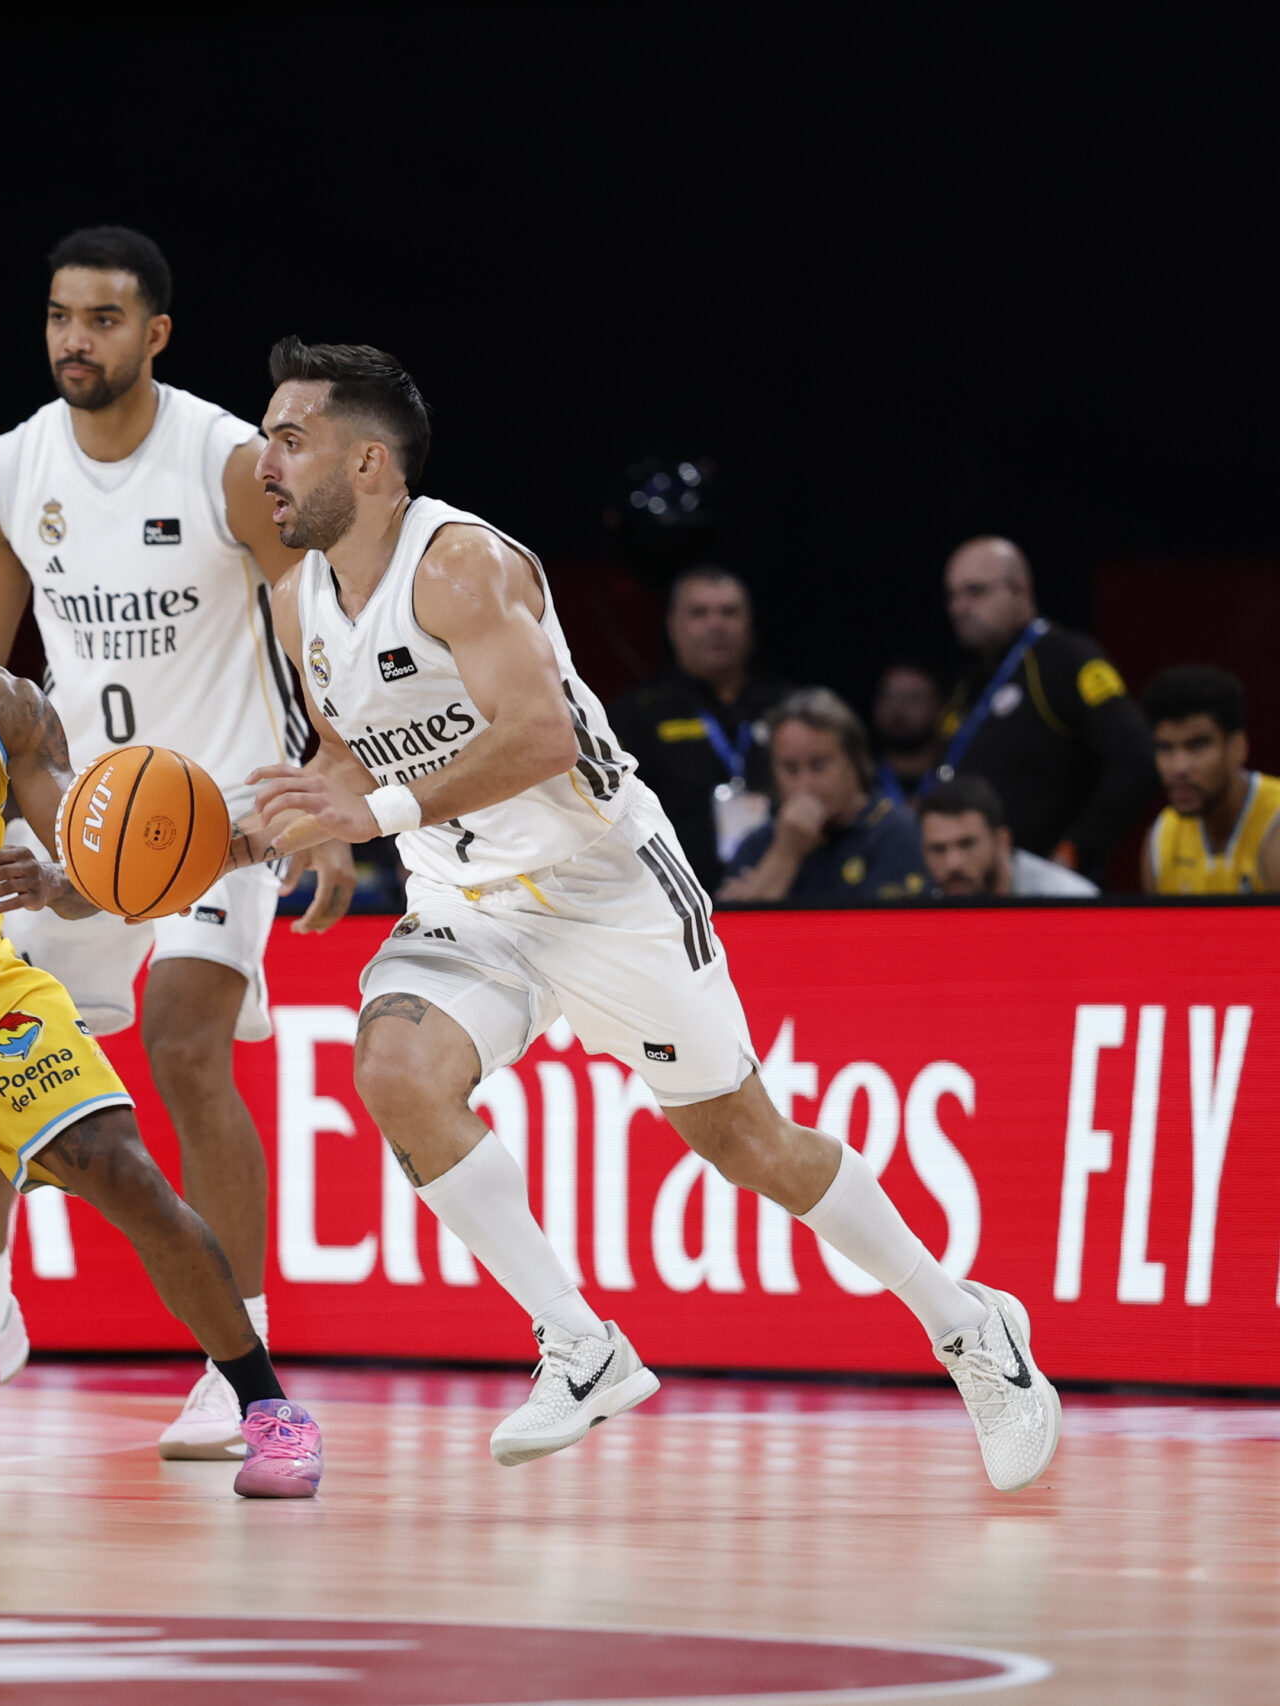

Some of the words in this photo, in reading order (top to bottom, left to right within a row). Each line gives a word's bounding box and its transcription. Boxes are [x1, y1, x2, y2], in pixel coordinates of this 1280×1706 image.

[42, 584, 200, 624] Emirates
[103, 625, 177, 660] BETTER
[383, 664, 416, 679] endesa
[101, 683, 136, 744] 0
[344, 702, 476, 769] mirates
[82, 783, 113, 853] EVO
[646, 1050, 670, 1061] acb
[11, 1086, 38, 1113] del
[1053, 1004, 1253, 1305] FLY
